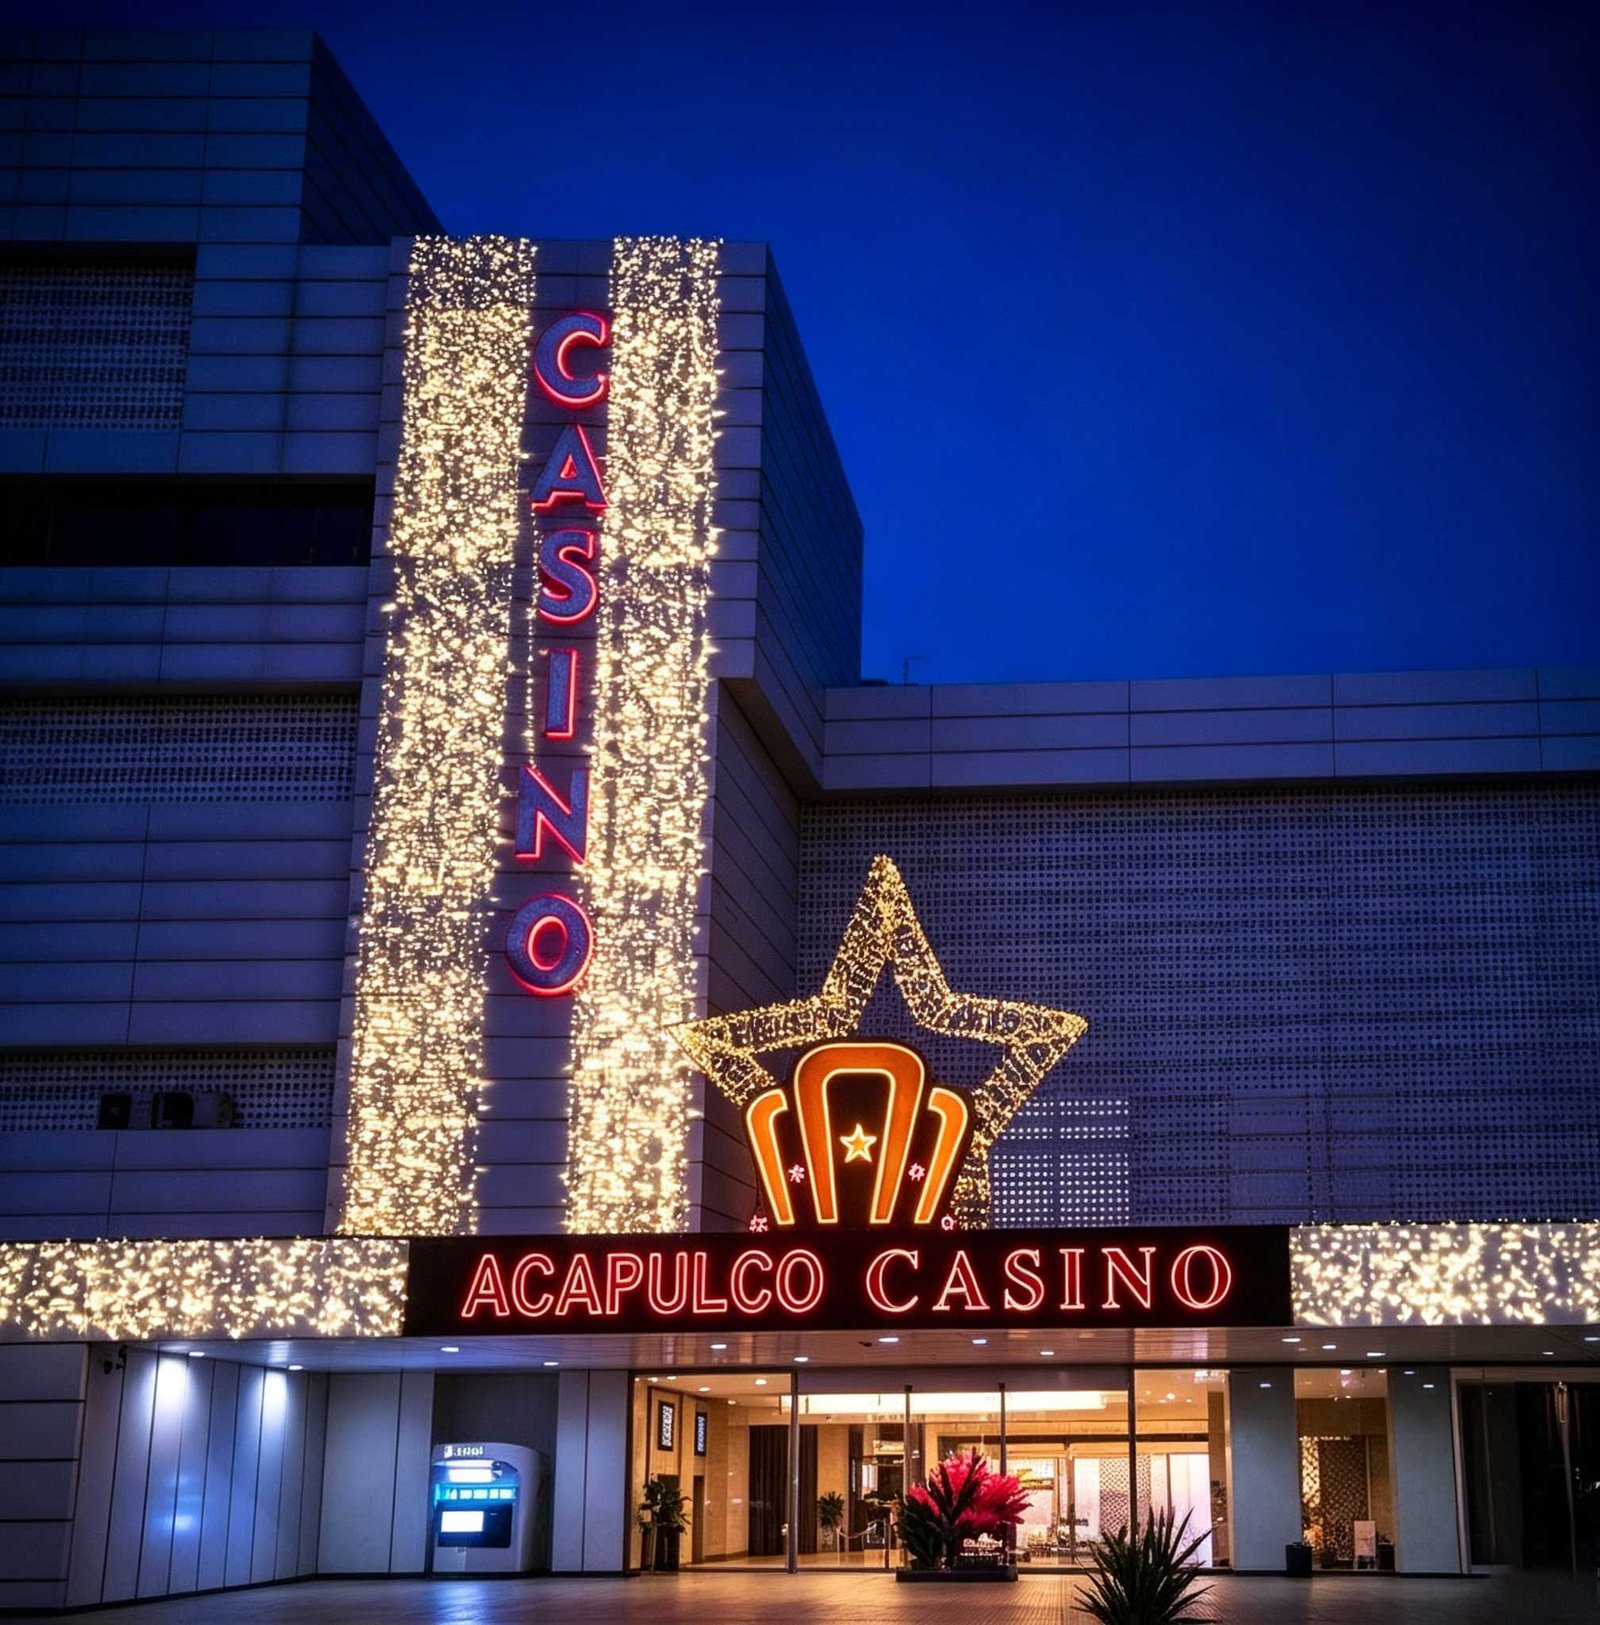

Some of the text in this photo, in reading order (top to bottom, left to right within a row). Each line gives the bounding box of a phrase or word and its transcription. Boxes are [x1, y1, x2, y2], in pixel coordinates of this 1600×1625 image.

[505, 310, 609, 996] CASINO
[460, 1245, 1232, 1317] ACAPULCO CASINO
